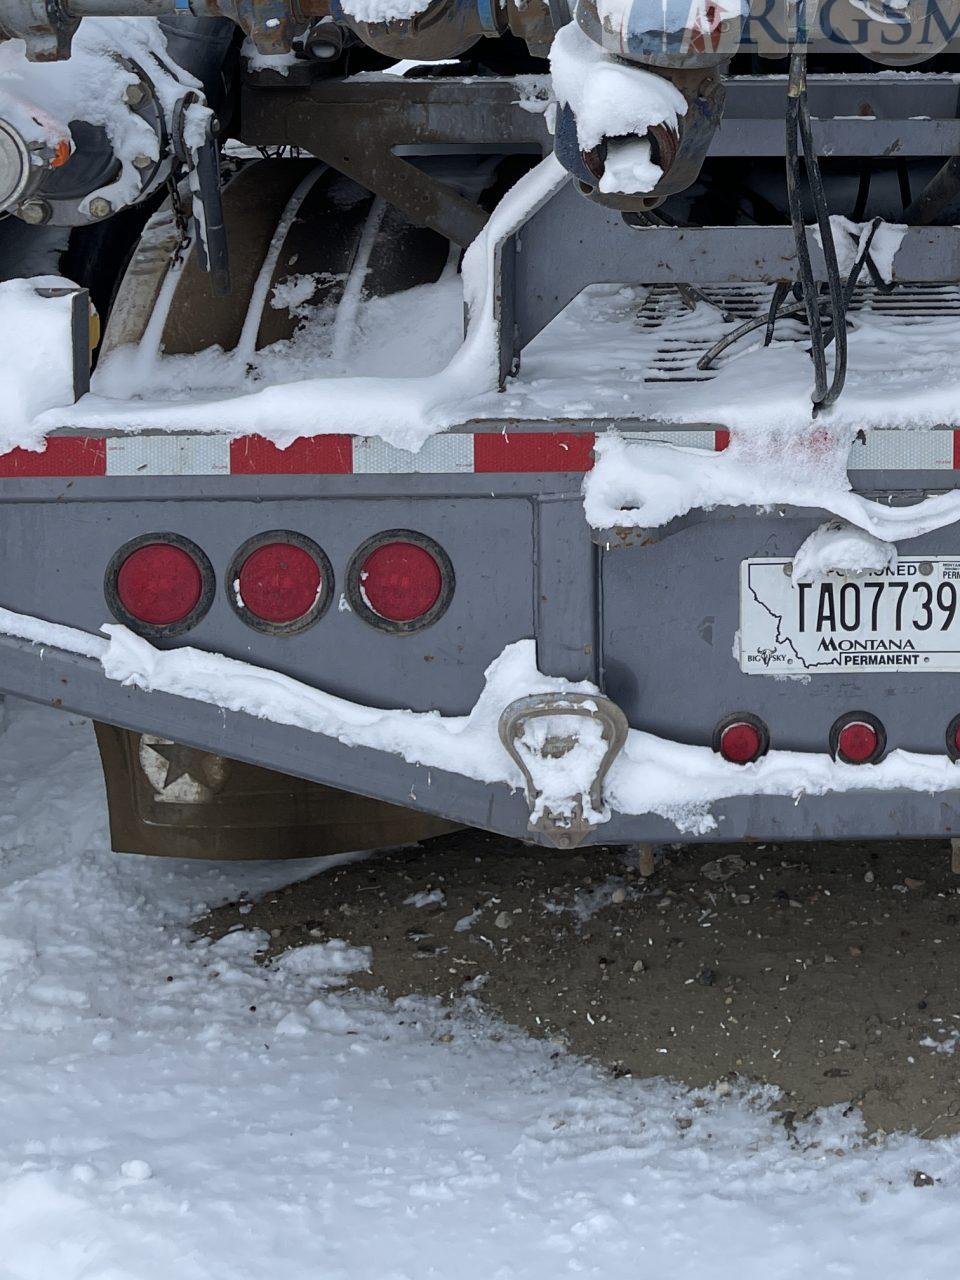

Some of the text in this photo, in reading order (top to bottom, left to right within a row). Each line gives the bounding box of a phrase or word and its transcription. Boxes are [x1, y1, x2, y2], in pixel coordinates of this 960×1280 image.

[793, 581, 957, 633] TA07739
[817, 636, 915, 652] MONTANA
[772, 654, 786, 662] SKY
[844, 654, 920, 665] PERMANENT
